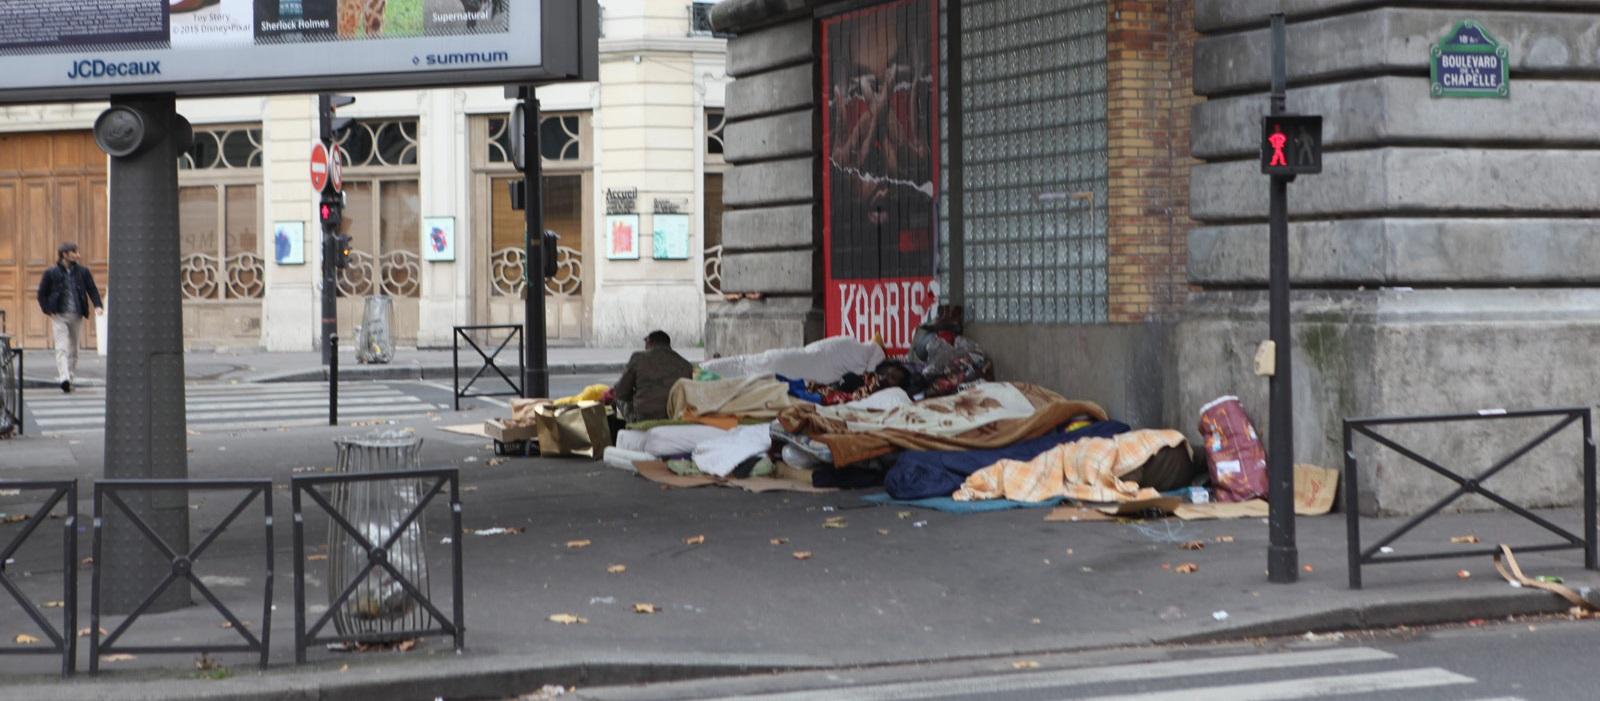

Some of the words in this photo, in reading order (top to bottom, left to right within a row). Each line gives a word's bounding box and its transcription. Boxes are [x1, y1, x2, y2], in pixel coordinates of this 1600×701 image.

[209, 12, 229, 22] Story
[432, 9, 488, 22] Supernatural
[261, 19, 296, 32] Sherlock
[298, 18, 330, 30] Holmes
[426, 50, 509, 65] summum
[1442, 55, 1497, 68] BOULEVARD
[67, 60, 161, 79] JCDecaux
[1443, 74, 1497, 87] CHAPELLE
[606, 186, 638, 200] Accueil
